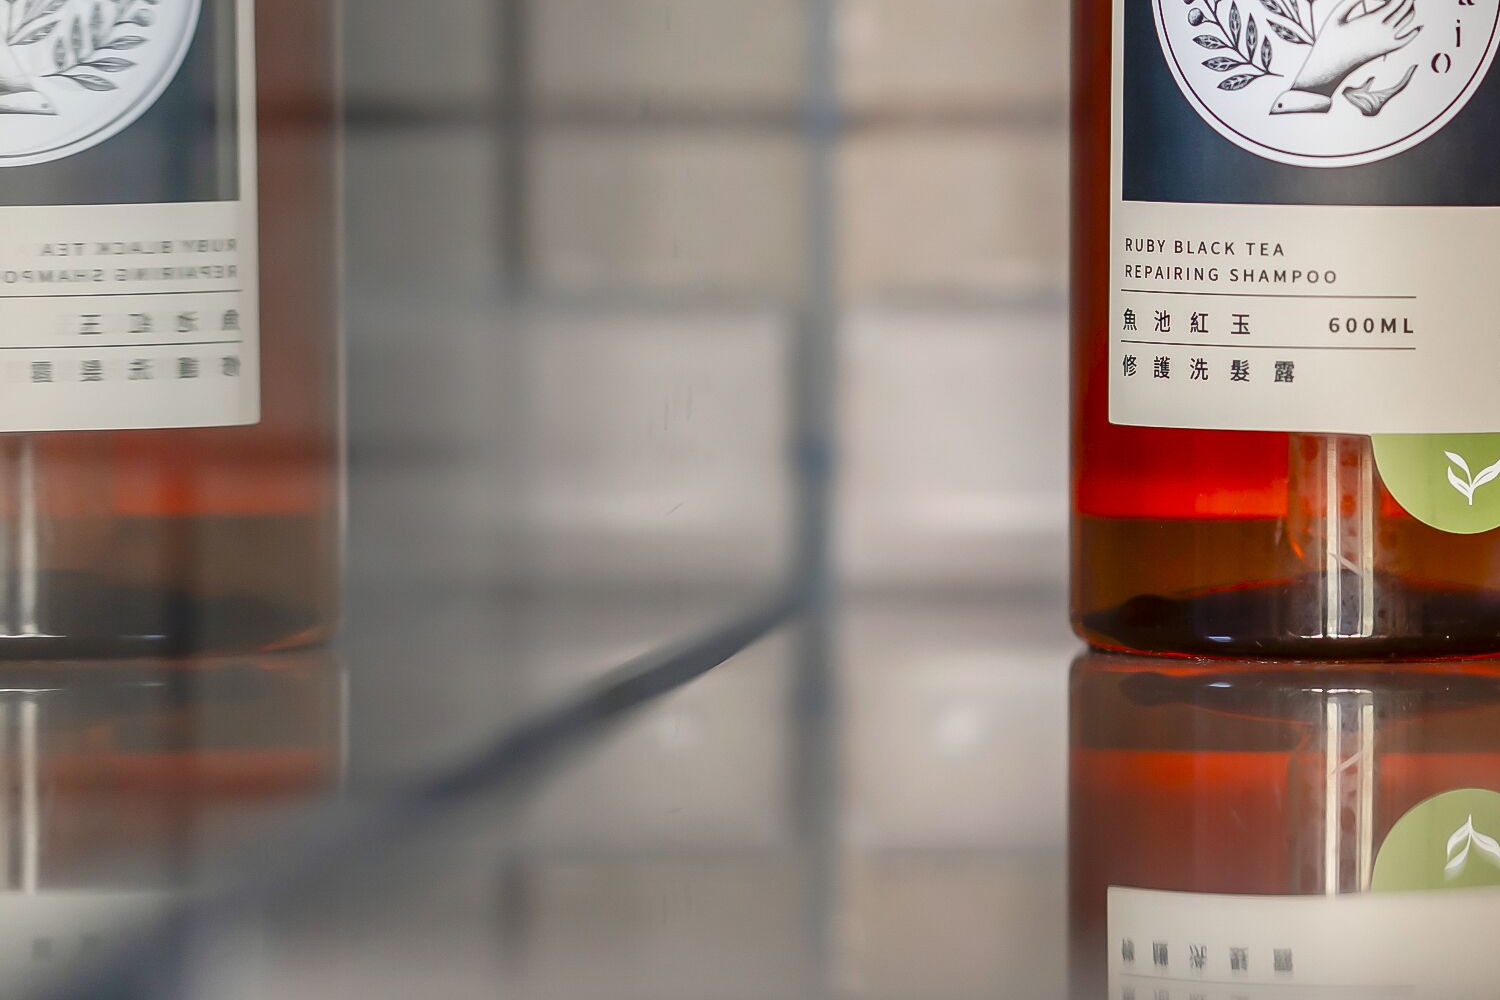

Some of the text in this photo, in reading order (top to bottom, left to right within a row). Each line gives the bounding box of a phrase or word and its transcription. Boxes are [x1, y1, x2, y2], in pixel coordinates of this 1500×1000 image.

[1125, 237, 1285, 257] RUBY BLACK TEA
[1124, 264, 1337, 284] REPAIRING SHAMPOO
[1122, 307, 1251, 335] 魚池紅玉
[1328, 317, 1415, 334] 600ML
[1122, 353, 1295, 384] 修護洗髮露
